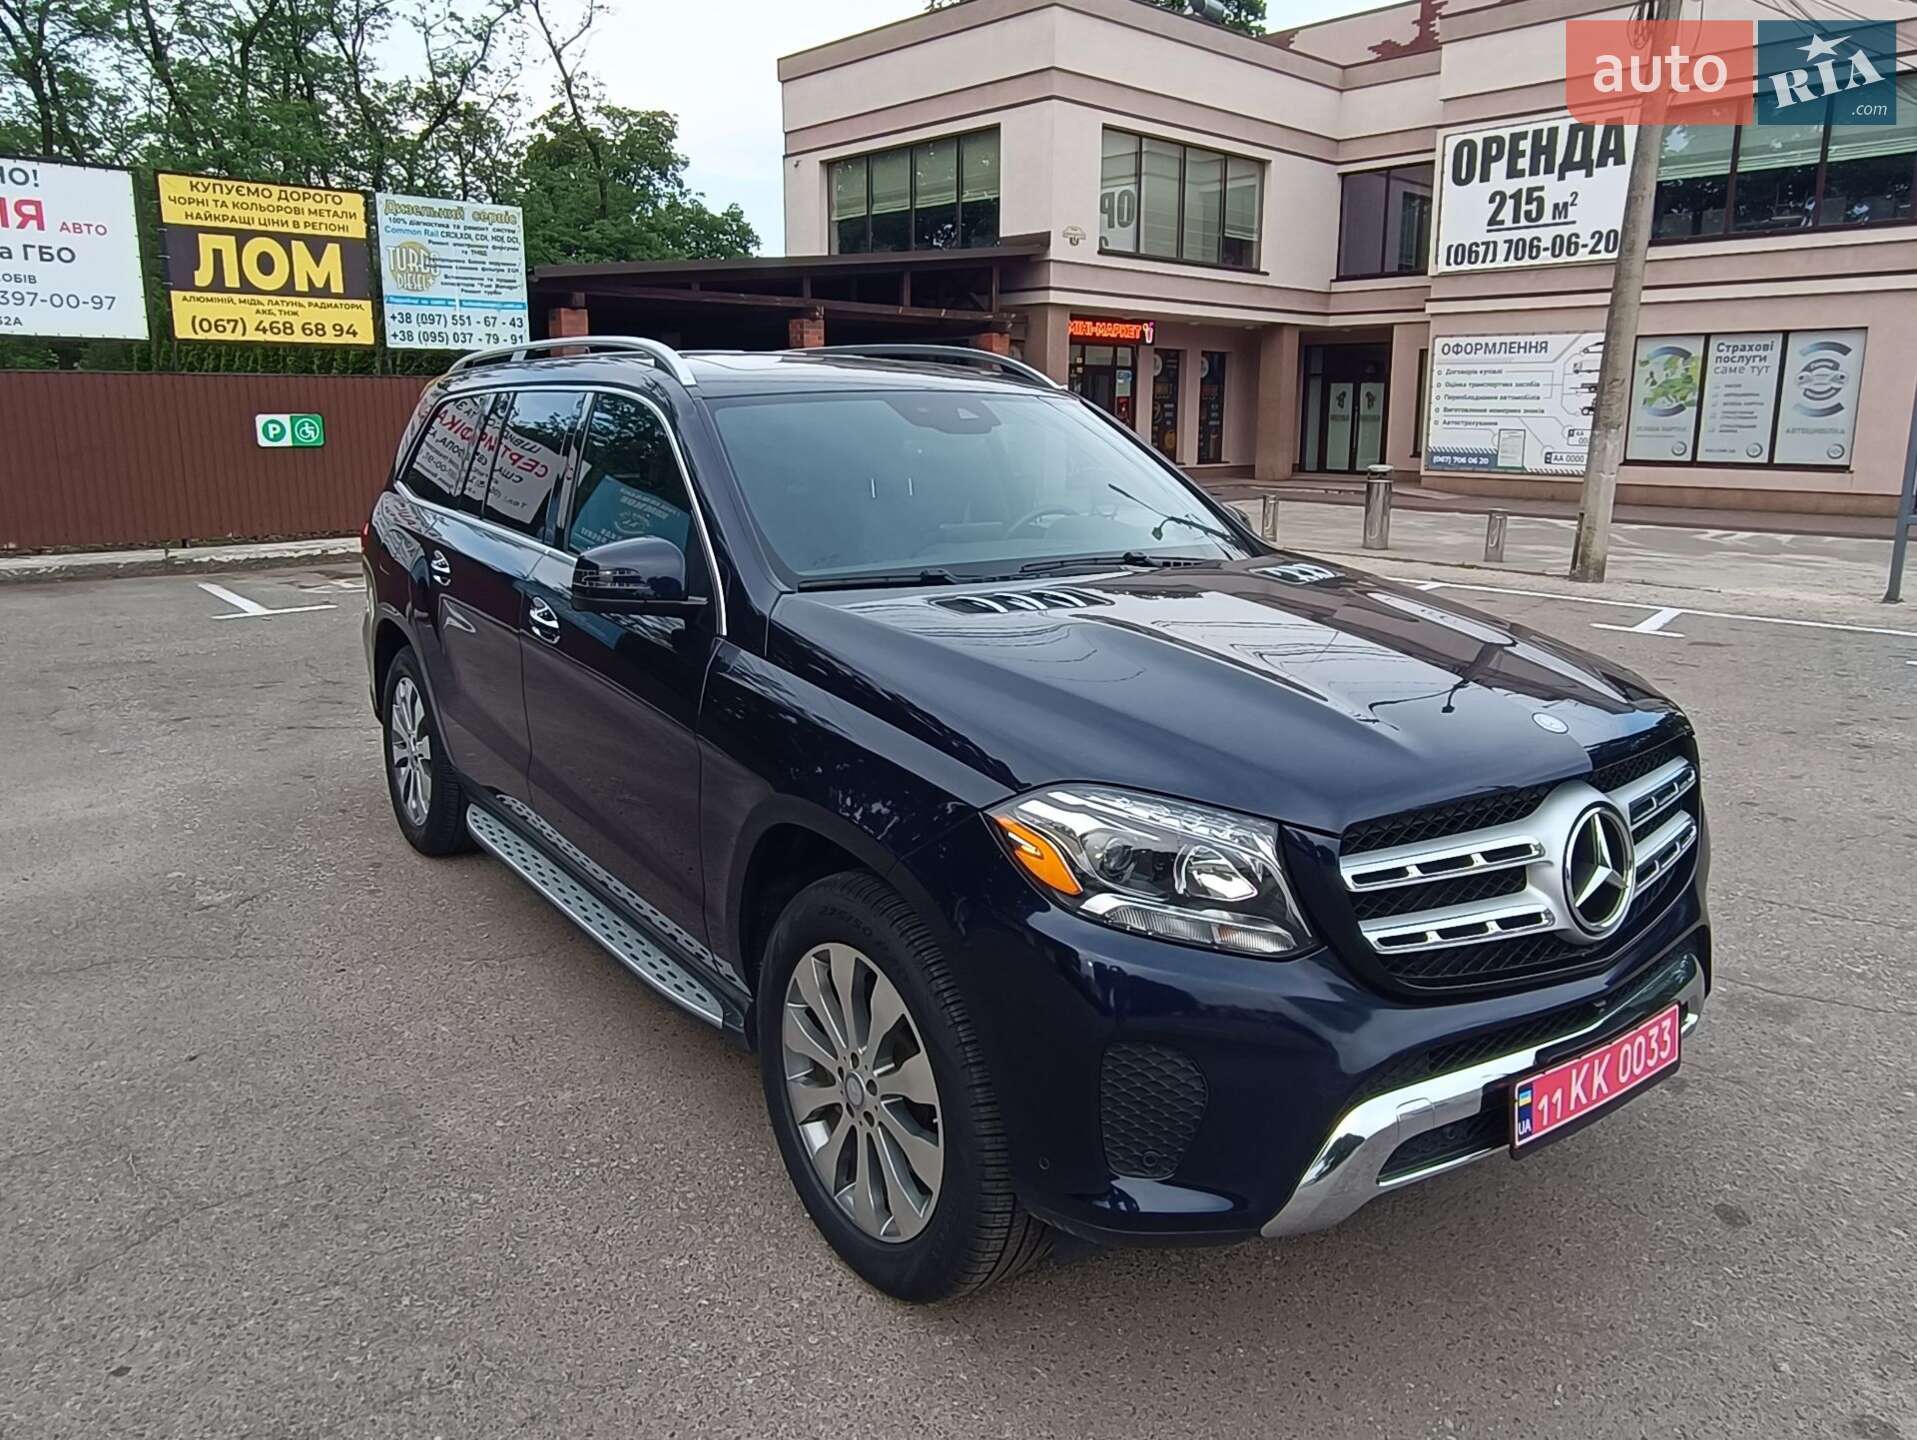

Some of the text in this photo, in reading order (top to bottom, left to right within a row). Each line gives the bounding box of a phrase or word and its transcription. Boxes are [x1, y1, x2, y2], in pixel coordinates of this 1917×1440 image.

[1451, 116, 1627, 187] ОРЕНДА
[189, 180, 343, 206] КУПУЄМО ДОРОГО
[168, 195, 357, 220] ЧОРНІ ТА КОЛЬОРОВІ МЕТАЛИ
[1487, 185, 1546, 227] 215
[59, 221, 108, 236] АВТО
[184, 210, 349, 233] НАЙКРАЩІ ЦІНИ В РЕГІОНІ
[384, 225, 423, 236] Common
[424, 229, 439, 237] Rail
[22, 244, 76, 263] ГБО
[1445, 228, 1620, 267] (067) 706-06-20
[194, 233, 344, 294] ЛОМ
[182, 295, 236, 305] АЛЮМІНІЙ,
[191, 315, 359, 338] (067) 468 68 94
[390, 312, 413, 324] +38
[416, 313, 448, 328] (097)
[451, 314, 472, 328] 551
[483, 316, 498, 328] 67
[509, 317, 524, 328] 43
[391, 330, 414, 342] +38
[418, 331, 449, 345] (095)
[452, 332, 473, 344] 037
[485, 333, 500, 345] 79
[510, 334, 524, 345] 91
[1441, 341, 1549, 356] ОФОРМЛЕННЯ
[1716, 340, 1775, 354] Страхові
[1714, 354, 1768, 367] послуги
[1713, 365, 1771, 377] саме тут
[267, 423, 281, 439] P
[1618, 1017, 1672, 1084] 0033
[1517, 1118, 1532, 1136] UA
